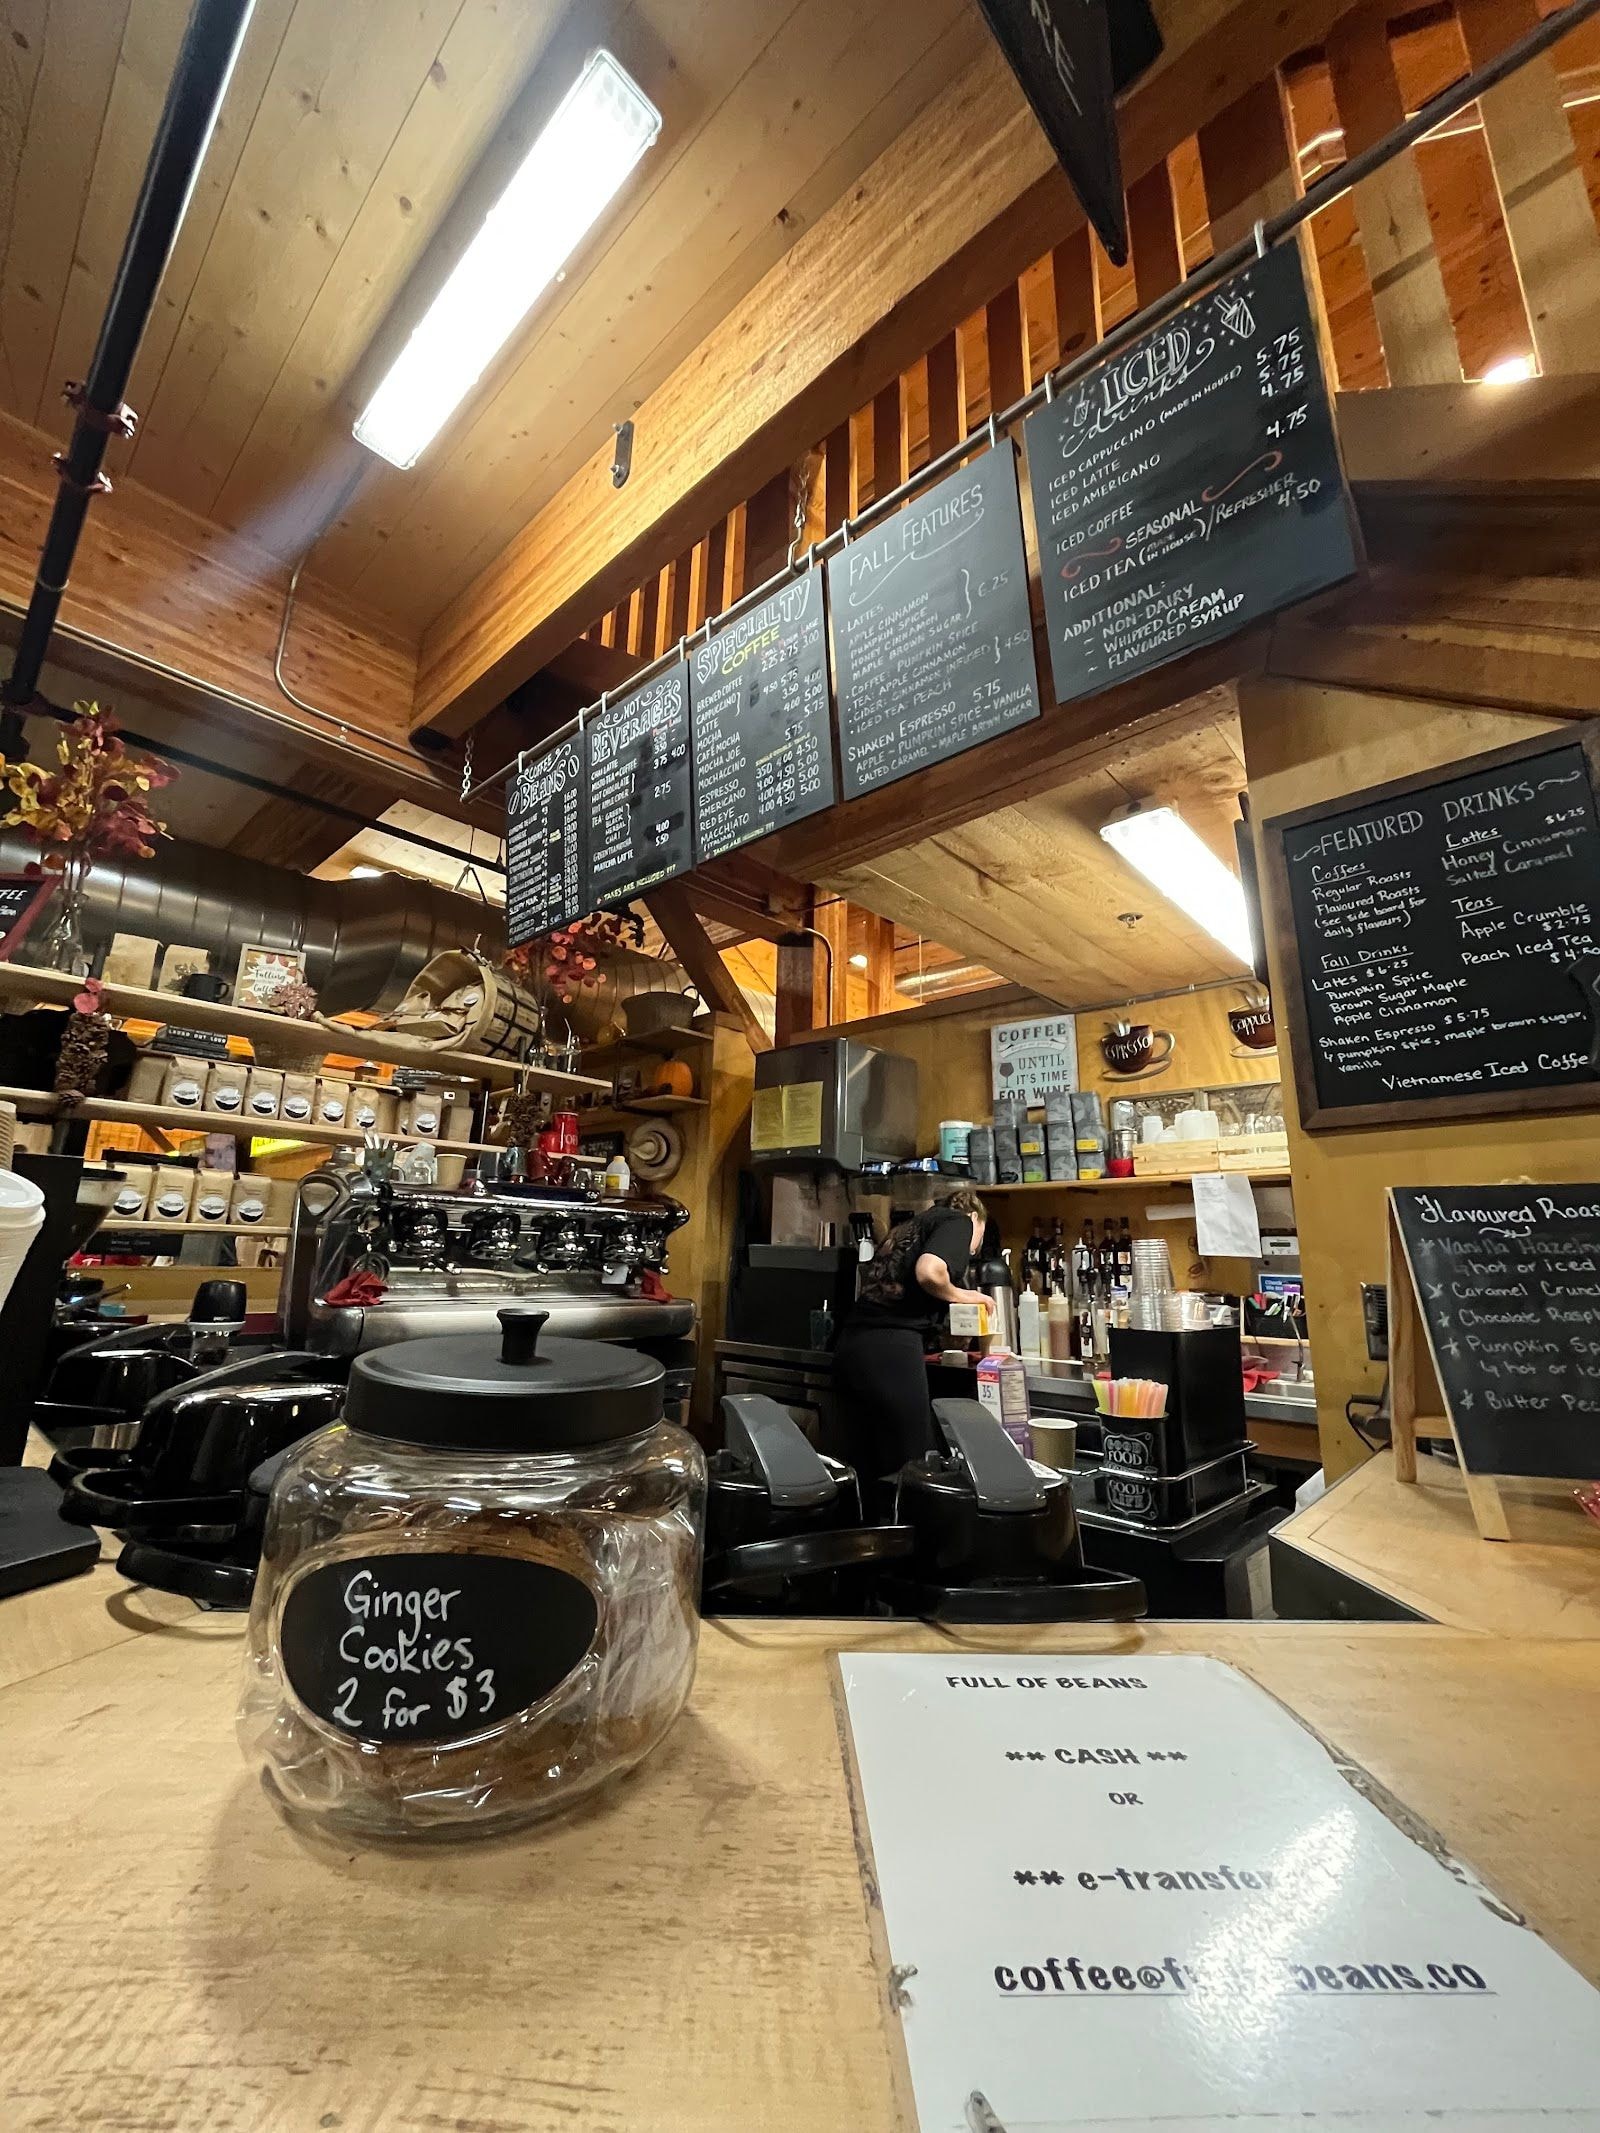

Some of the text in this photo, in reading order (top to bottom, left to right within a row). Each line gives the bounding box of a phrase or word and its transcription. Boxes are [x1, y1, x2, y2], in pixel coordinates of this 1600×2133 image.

[1101, 326, 1191, 416] ICED
[1049, 468, 1077, 493] ICED
[1078, 419, 1155, 472] CAPPUCCINO
[1191, 390, 1202, 403] IN
[1256, 327, 1300, 367] 5.75
[1050, 345, 1304, 509] ICED LATTE 5.75
[1051, 365, 1304, 525] ICED AMERICANO 4.75
[1056, 403, 1309, 555] ICED COFFEE 4.75
[850, 484, 983, 587] FALL FEATURES
[1063, 573, 1101, 603] ICED
[1103, 556, 1137, 581] TEA
[1277, 479, 1321, 508] 4.50
[1125, 500, 1203, 550] SEASONAL
[1063, 581, 1166, 643] ADDITIONAL:
[1102, 583, 1194, 640] NON-DAIRY
[1103, 587, 1226, 655] WHIPPED CREAM
[696, 578, 811, 685] SPECIALTY
[1108, 593, 1246, 671] FLAVOURED SYRUP
[721, 624, 781, 675] COFFEE
[591, 686, 682, 766] BEVERAGES
[847, 732, 896, 763] SHAKEN
[899, 701, 957, 738] ESPRESSO
[973, 679, 1001, 703] 5.75
[520, 764, 566, 815] BEANS
[699, 779, 739, 807] ESPRESSO
[699, 788, 747, 820] AMERICANO
[700, 813, 750, 845] MACCHIATO
[718, 806, 736, 825] EYE
[1320, 781, 1535, 857] FEATURED DRINKS
[1441, 826, 1587, 871] Honey Cinnamon
[1446, 827, 1499, 848] Lattes
[1446, 844, 1574, 887] Salted Caramel
[1311, 871, 1412, 902] Regular Roasts
[1316, 886, 1421, 916] Flavoured Roasts
[1373, 900, 1406, 916] board
[1409, 897, 1428, 909] for
[1451, 896, 1494, 913] Teas
[1324, 926, 1355, 938] daily
[1461, 903, 1589, 940] Apple Crumble
[1321, 945, 1409, 970] Fall Drinks
[1461, 934, 1593, 966] Peach Iced Tea
[1311, 974, 1359, 992] Lattes
[1325, 970, 1434, 1001] Pumpkin Spice
[1329, 977, 1470, 1014] Brown Sugar Maple
[1333, 995, 1458, 1027] Apple Cinnamon
[998, 1022, 1067, 1043] COFFEE
[1319, 1034, 1370, 1048] Shaken
[1374, 1023, 1436, 1041] Espresso
[1337, 1044, 1396, 1063] pumpkin
[1444, 1026, 1487, 1041] maple
[1016, 1070, 1068, 1085] IT'S TIME
[1018, 1054, 1065, 1070] UNTIL
[1338, 1059, 1383, 1074] vanilla
[1381, 1068, 1484, 1090] Vietnamese
[1483, 1060, 1530, 1078] Iced
[999, 1088, 1026, 1100] FOR
[1414, 1194, 1536, 1223] Flavoured
[1545, 1257, 1597, 1272] iced
[1451, 1280, 1529, 1298] Caramel
[1465, 1335, 1560, 1355] Pumpkin
[1484, 1389, 1551, 1410] Butter
[1108, 1450, 1142, 1465] FOOD
[1109, 1480, 1145, 1494] GOOD
[343, 1569, 462, 1647] Ginger
[339, 1624, 474, 1674] Cookies
[331, 1668, 496, 1730] 2 for $3
[945, 1676, 1149, 1690] FULL OF BEANS
[1054, 1748, 1141, 1765] CASH
[1108, 1791, 1144, 1806] OR
